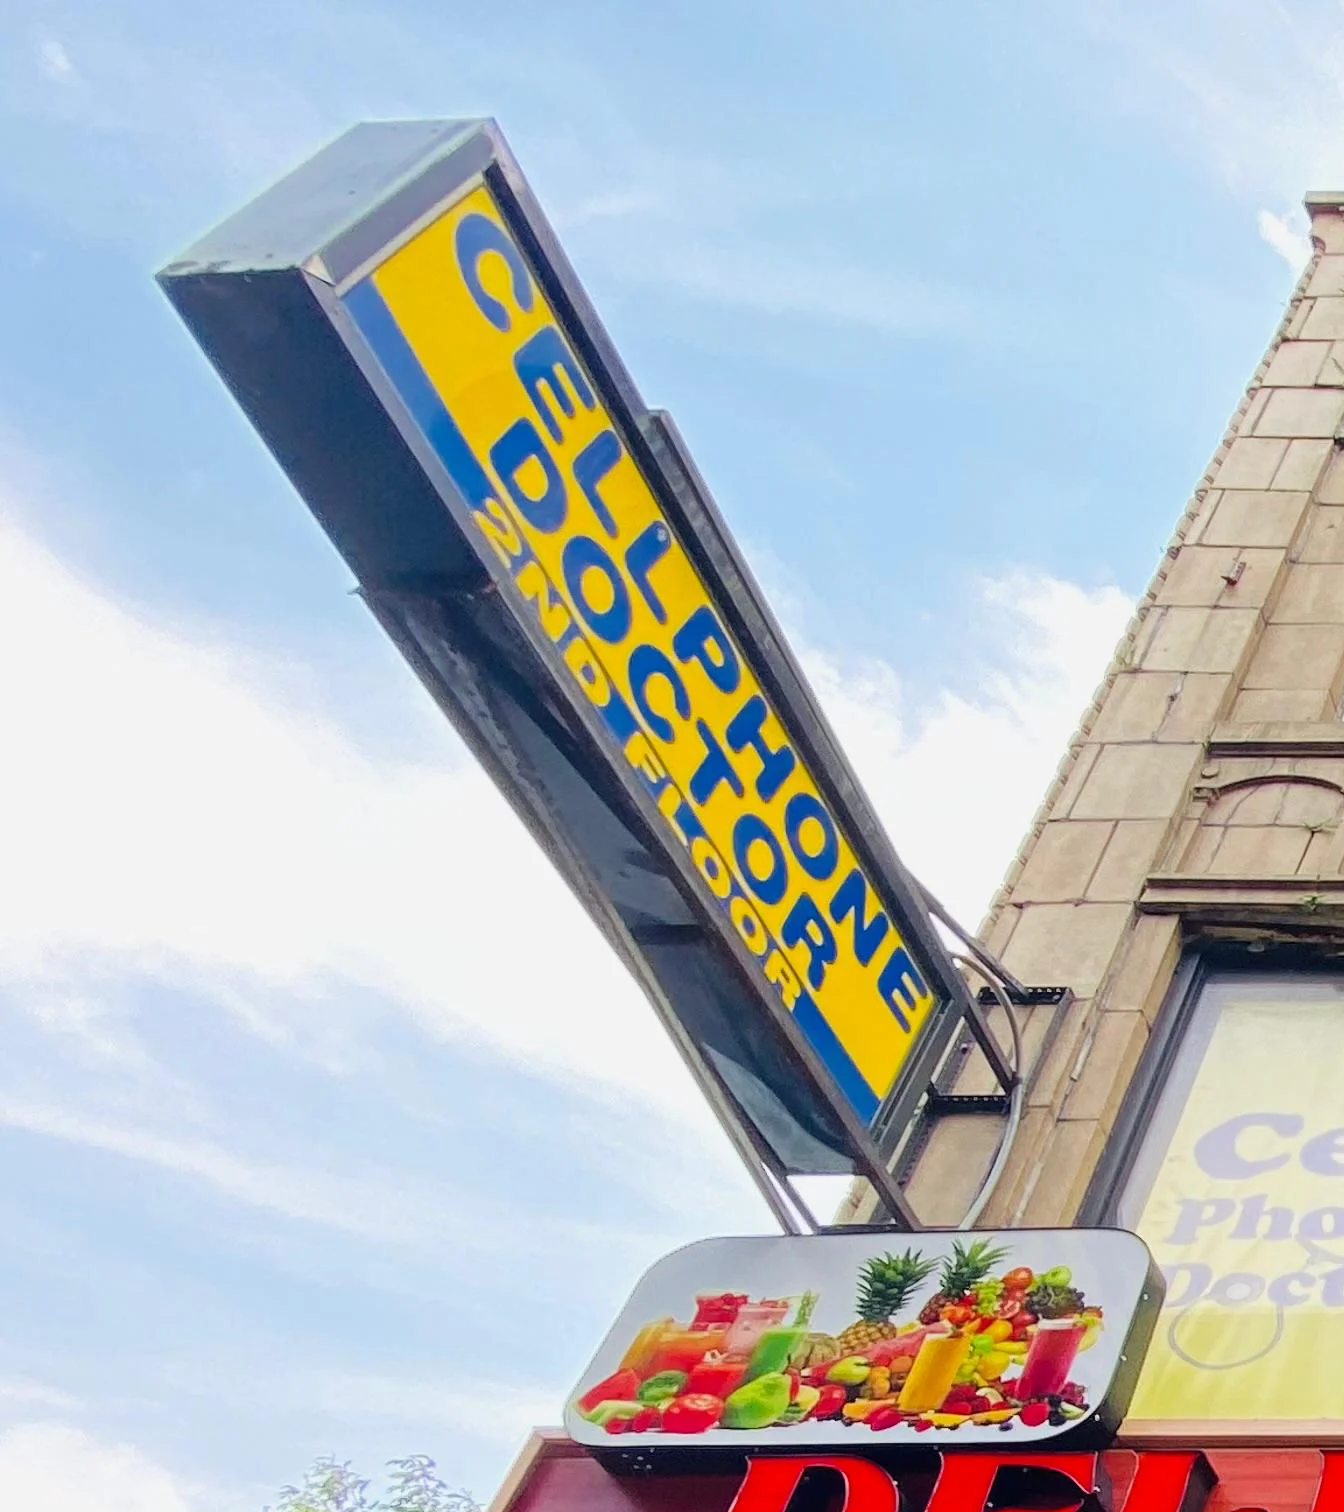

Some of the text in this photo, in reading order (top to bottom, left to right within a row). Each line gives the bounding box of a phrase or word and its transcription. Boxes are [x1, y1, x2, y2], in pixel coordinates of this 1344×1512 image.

[472, 496, 803, 1012] 2ND FLOOR
[489, 417, 838, 991] DOCTOR
